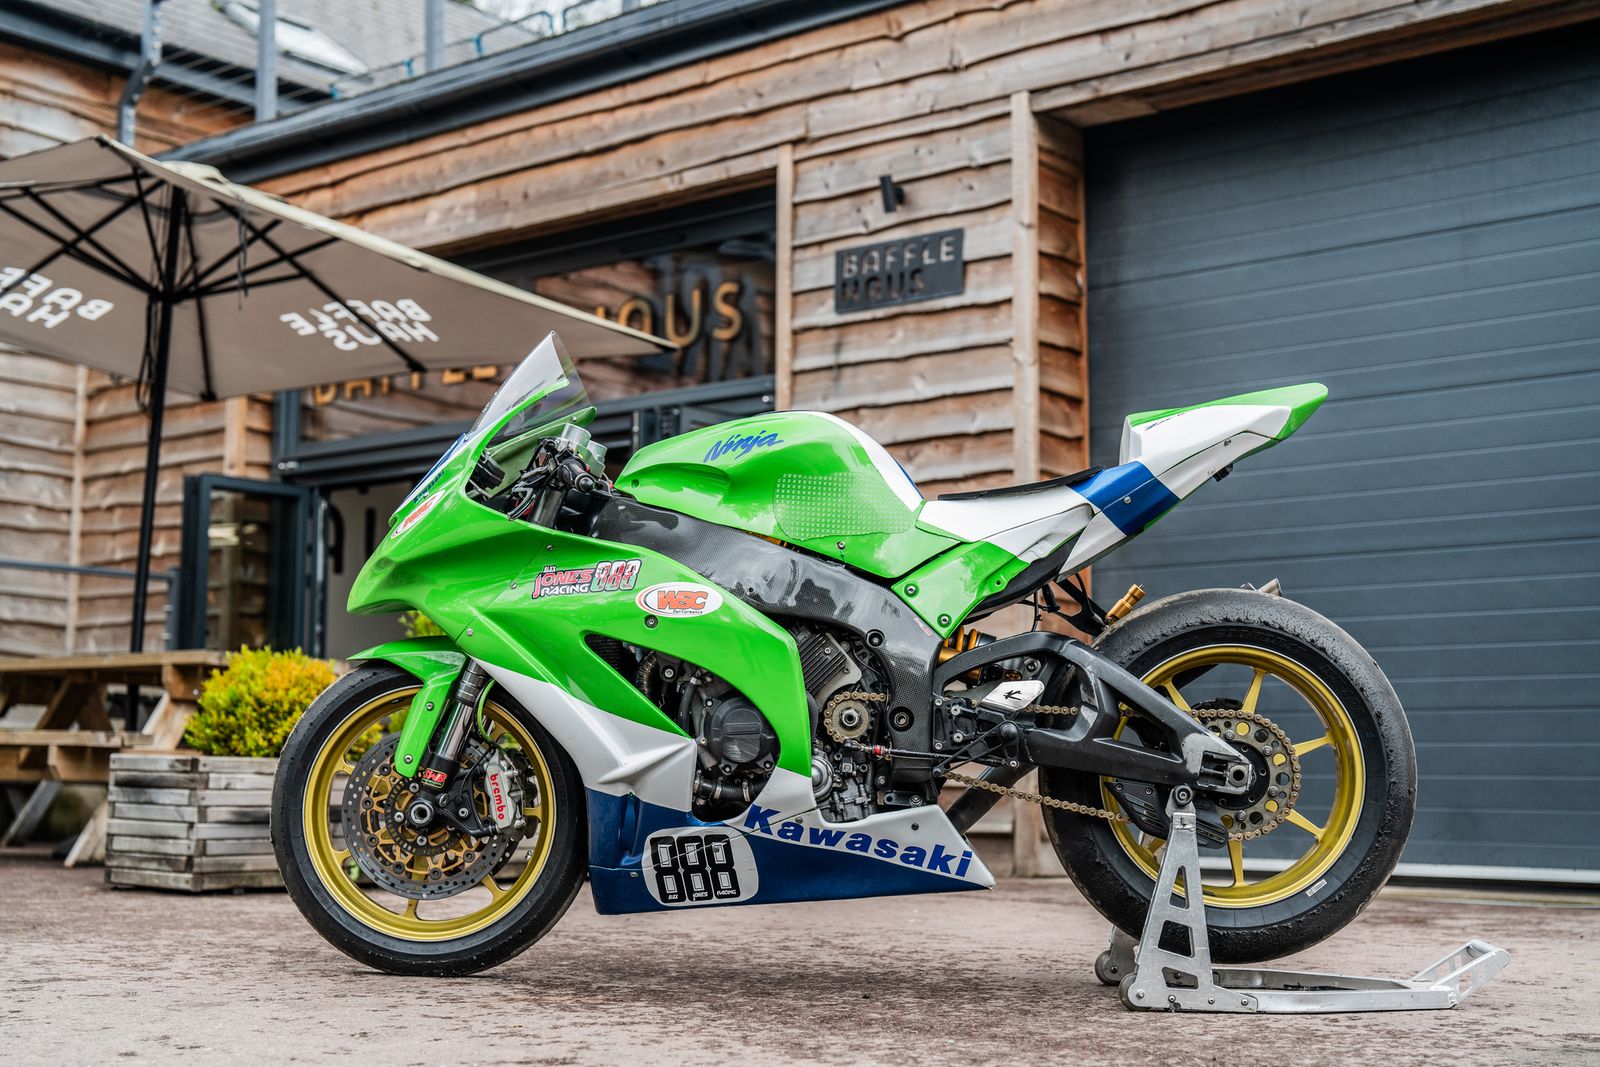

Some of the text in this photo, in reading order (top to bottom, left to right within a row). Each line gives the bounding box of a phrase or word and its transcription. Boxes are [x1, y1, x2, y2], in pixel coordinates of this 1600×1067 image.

[842, 236, 956, 279] BAFFLE
[841, 268, 925, 304] HAUS
[703, 430, 785, 463] Ninja
[532, 569, 593, 598] JONES
[541, 583, 591, 597] RACING
[489, 773, 505, 820] brembo
[743, 804, 973, 878] Kawasaki
[649, 834, 741, 903] 888
